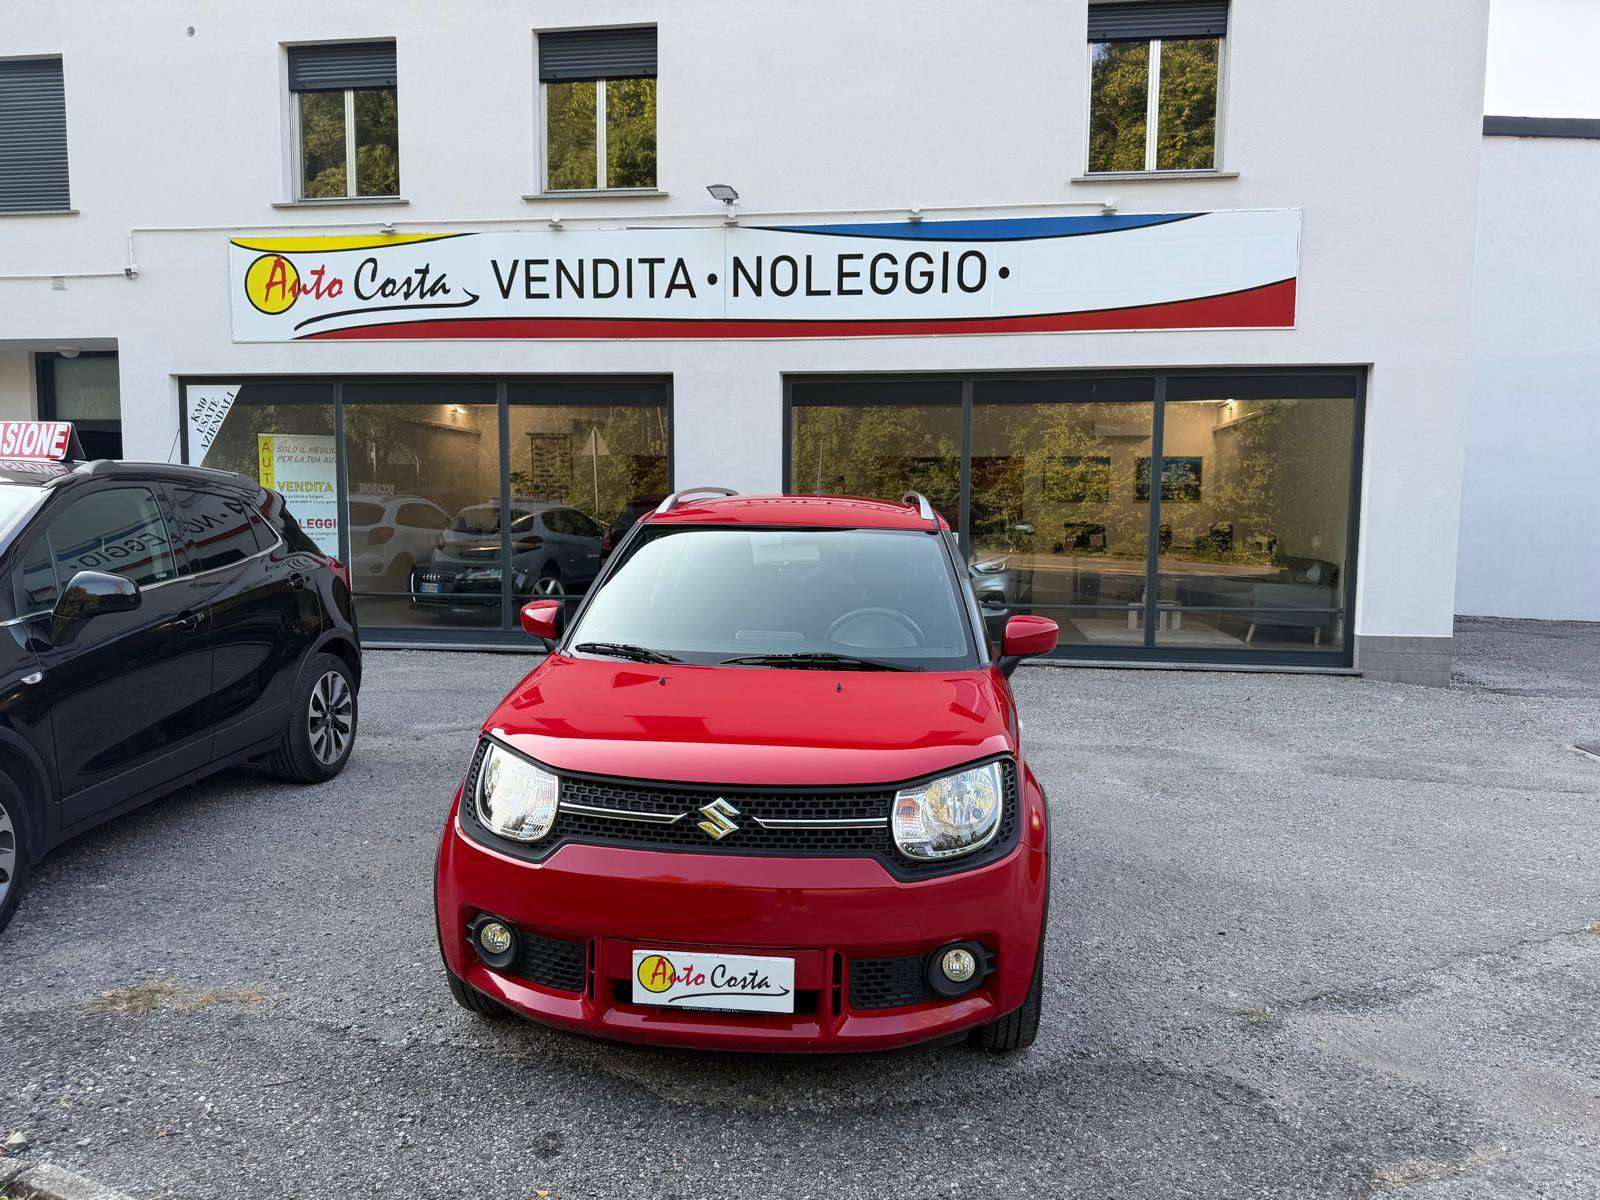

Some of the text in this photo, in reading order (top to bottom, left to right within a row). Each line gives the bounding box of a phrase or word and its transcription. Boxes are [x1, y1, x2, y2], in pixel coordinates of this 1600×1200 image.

[264, 255, 451, 303] Auto Costa
[490, 249, 987, 300] VENDITA NOLEGGIO
[196, 397, 220, 434] USATE
[200, 391, 235, 452] AZIENDALI
[261, 440, 272, 485] AUT
[276, 455, 293, 463] PER
[322, 456, 337, 464] AU
[277, 445, 297, 453] SOLO
[277, 480, 334, 493] VENDITA
[298, 518, 337, 529] LEGGI
[650, 956, 771, 990] Auto Costa
